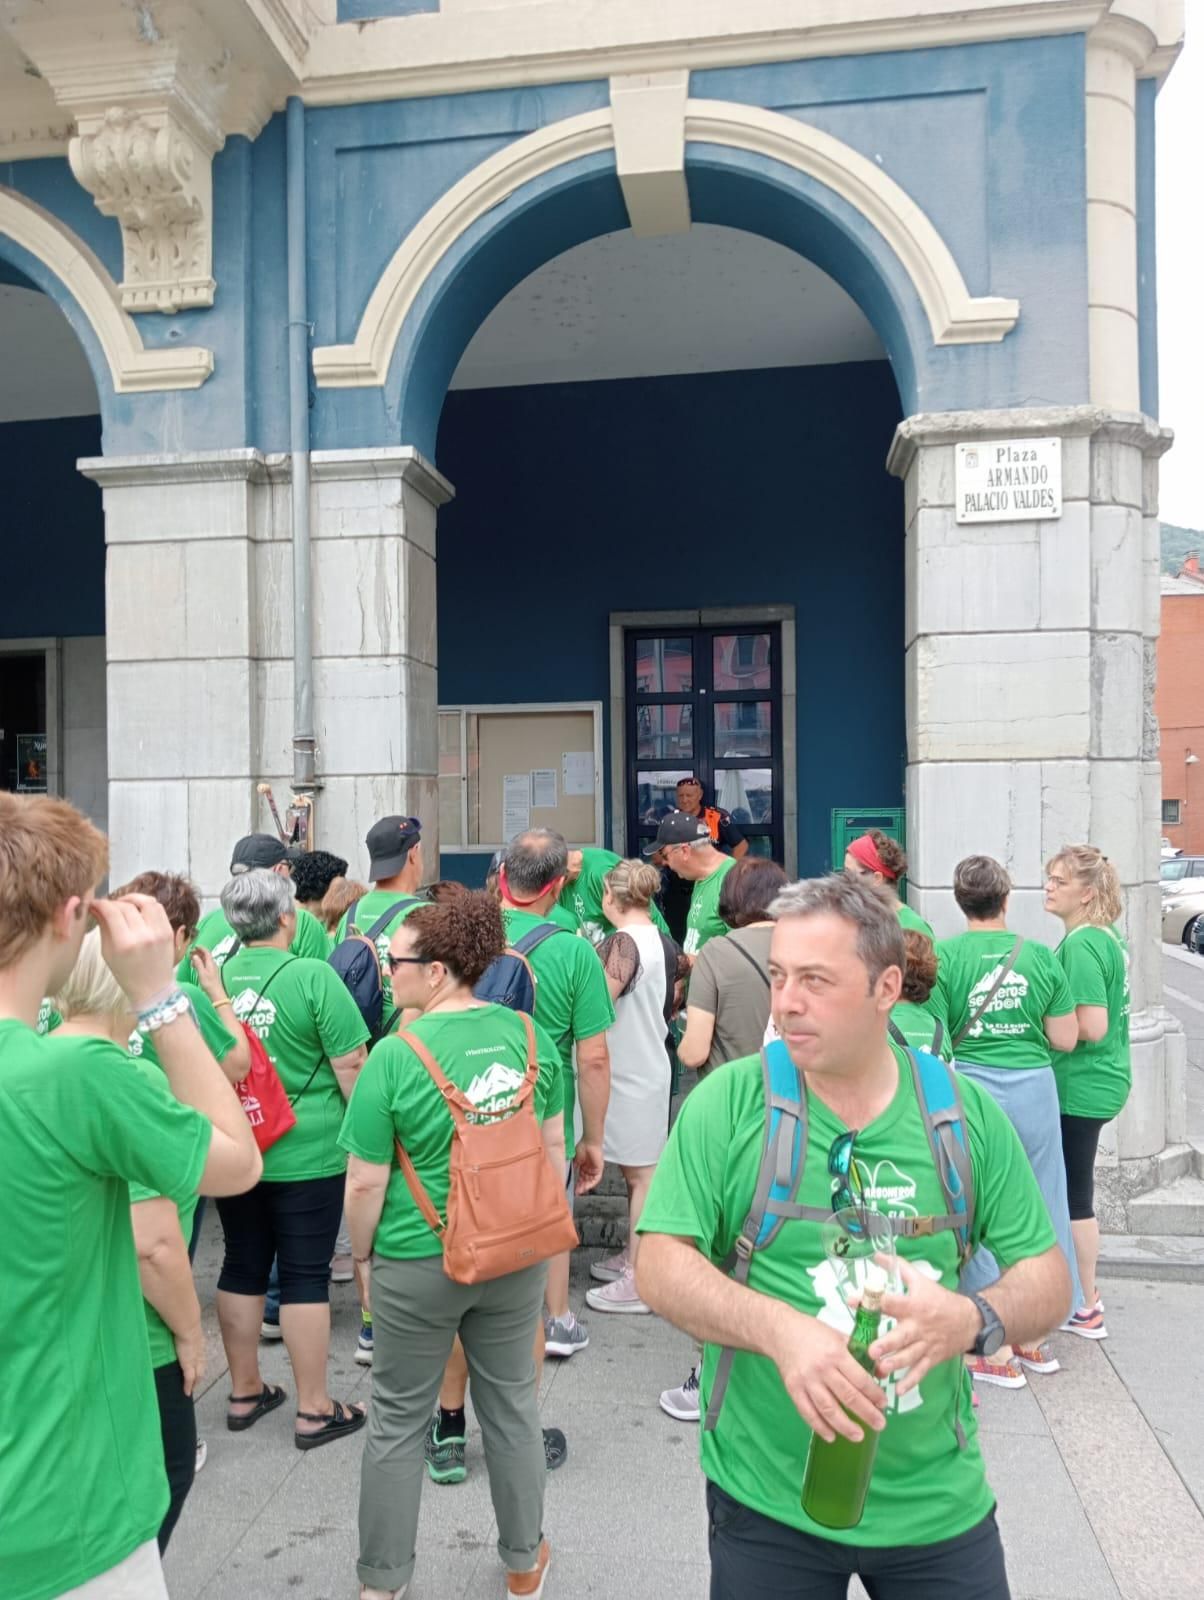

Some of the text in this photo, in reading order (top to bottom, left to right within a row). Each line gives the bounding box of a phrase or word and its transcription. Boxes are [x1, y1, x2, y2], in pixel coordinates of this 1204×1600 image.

[996, 446, 1037, 463] Plaza
[987, 465, 1048, 487] ARMANDO
[965, 488, 1054, 512] PALACIO VALDES
[968, 986, 1027, 1008] seeros
[863, 1186, 917, 1200] ARBONEROS
